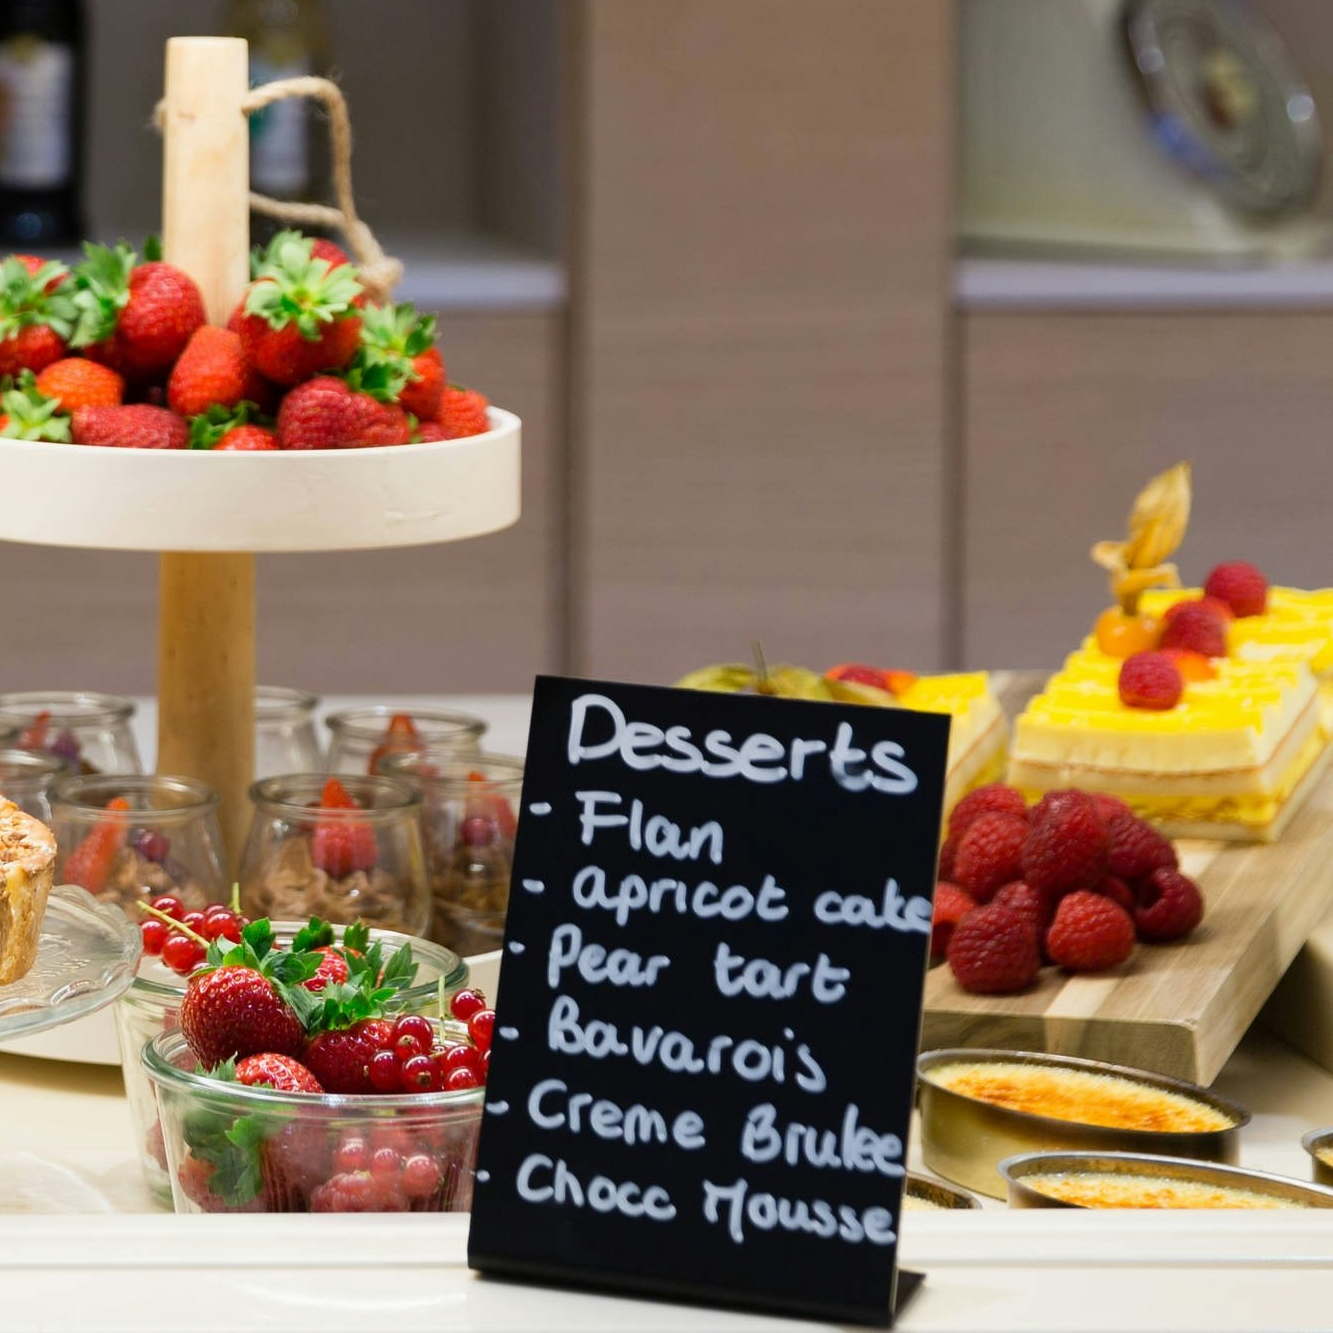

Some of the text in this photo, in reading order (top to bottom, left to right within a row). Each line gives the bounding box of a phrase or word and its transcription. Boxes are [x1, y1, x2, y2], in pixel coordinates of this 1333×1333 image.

[566, 692, 919, 795] Desserts
[574, 789, 724, 865] Flan
[813, 877, 933, 936] cake
[547, 922, 851, 1003] Pear tart
[547, 994, 827, 1093] Bavarois
[527, 1078, 907, 1177] Creme Brulee
[702, 1178, 898, 1244] Mousse
